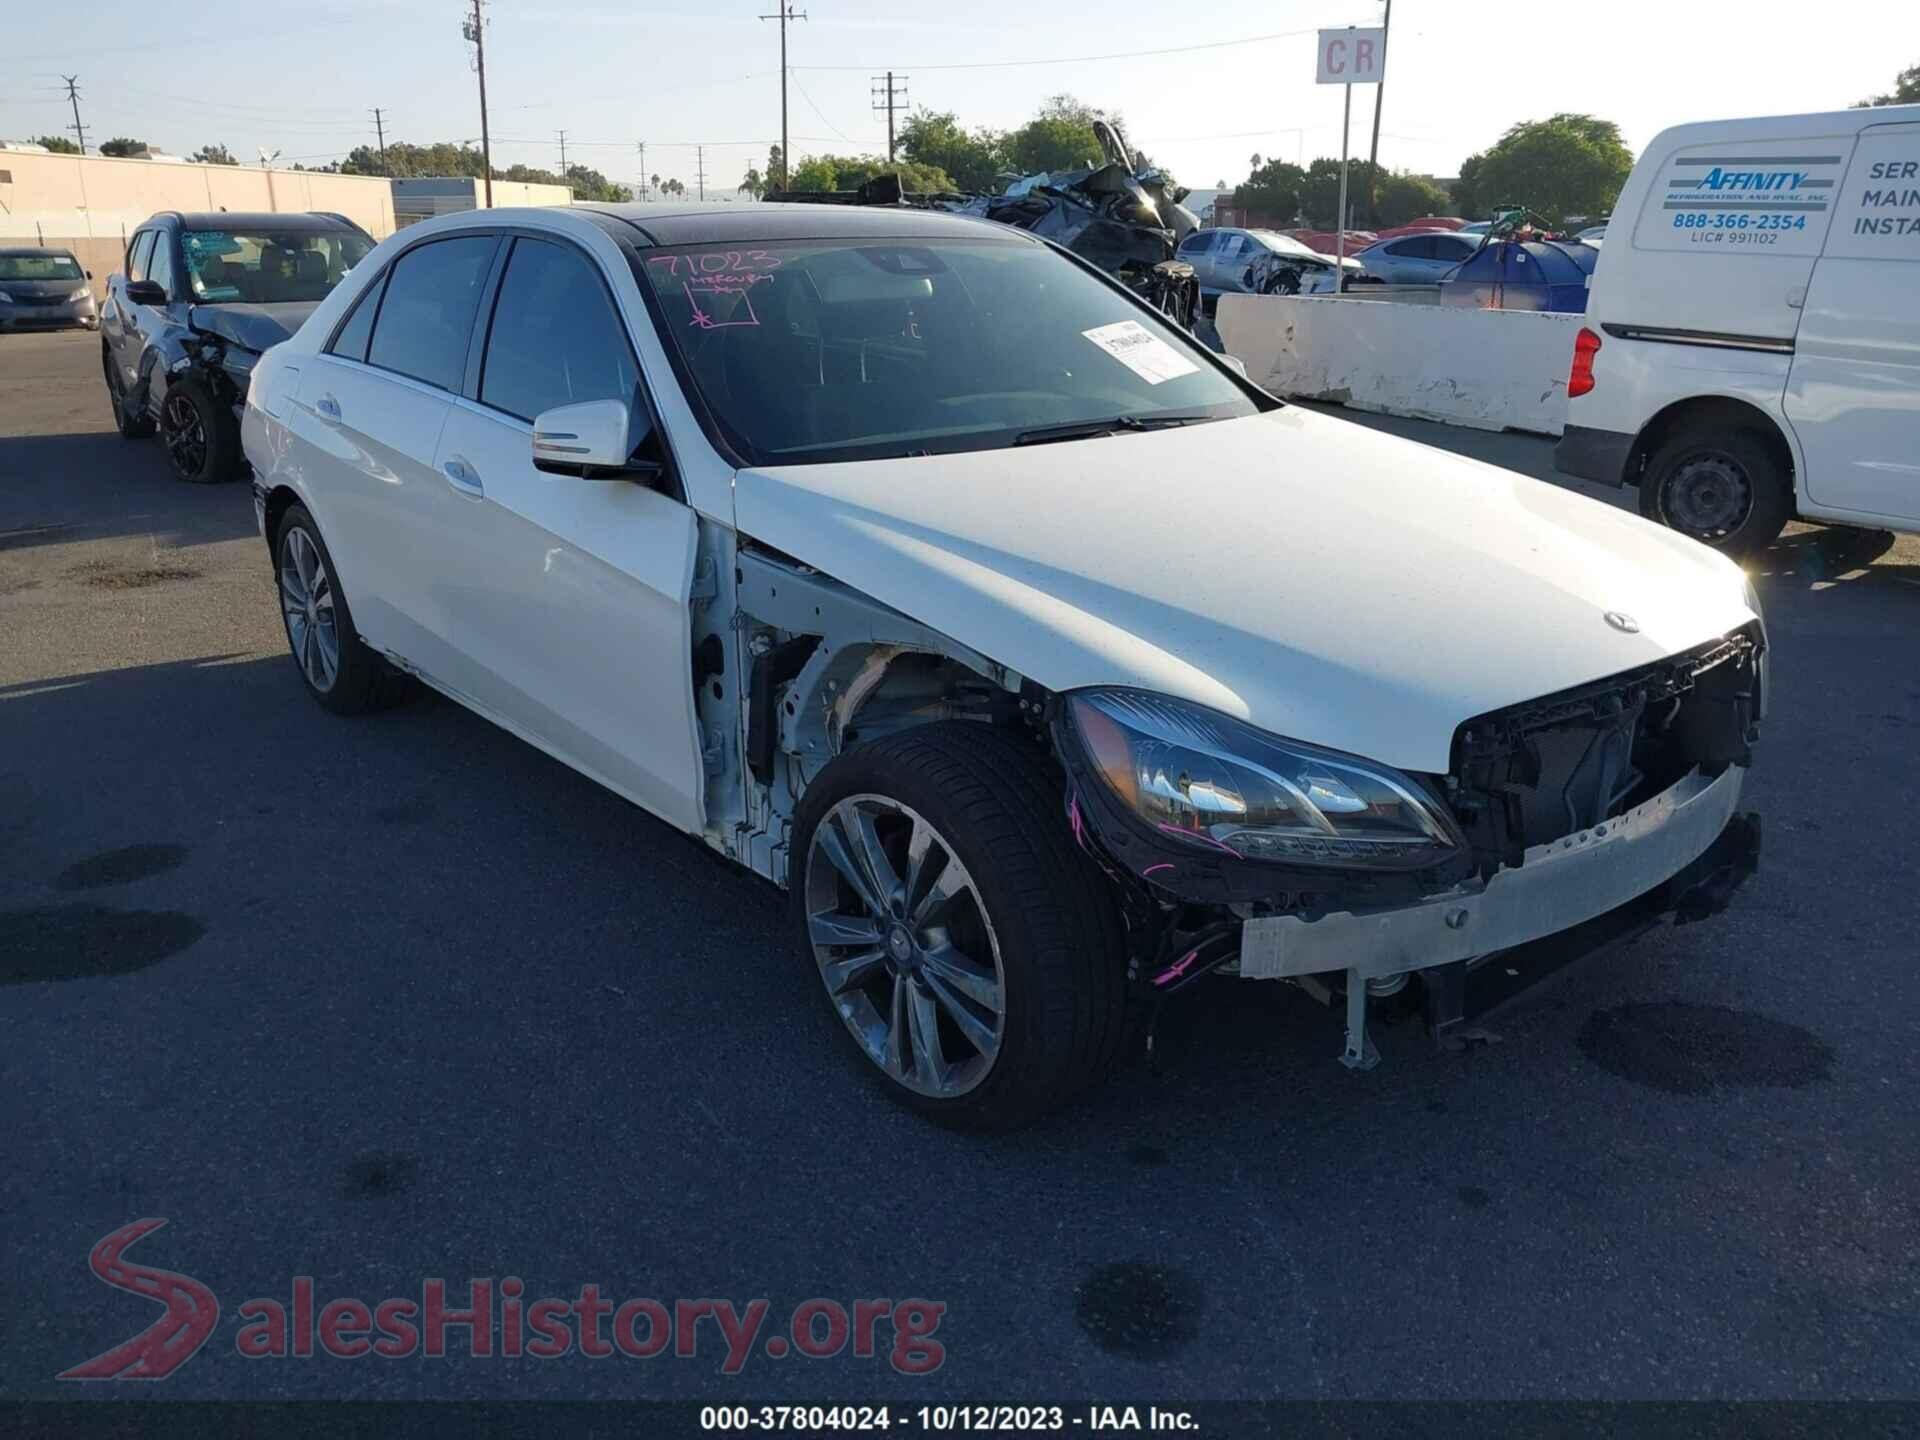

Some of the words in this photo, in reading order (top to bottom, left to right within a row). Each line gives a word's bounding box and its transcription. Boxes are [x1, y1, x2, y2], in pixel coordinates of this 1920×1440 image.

[1673, 213, 1806, 230] 888-366-2354
[1691, 232, 1723, 243] LIC#
[1729, 232, 1778, 244] 991102
